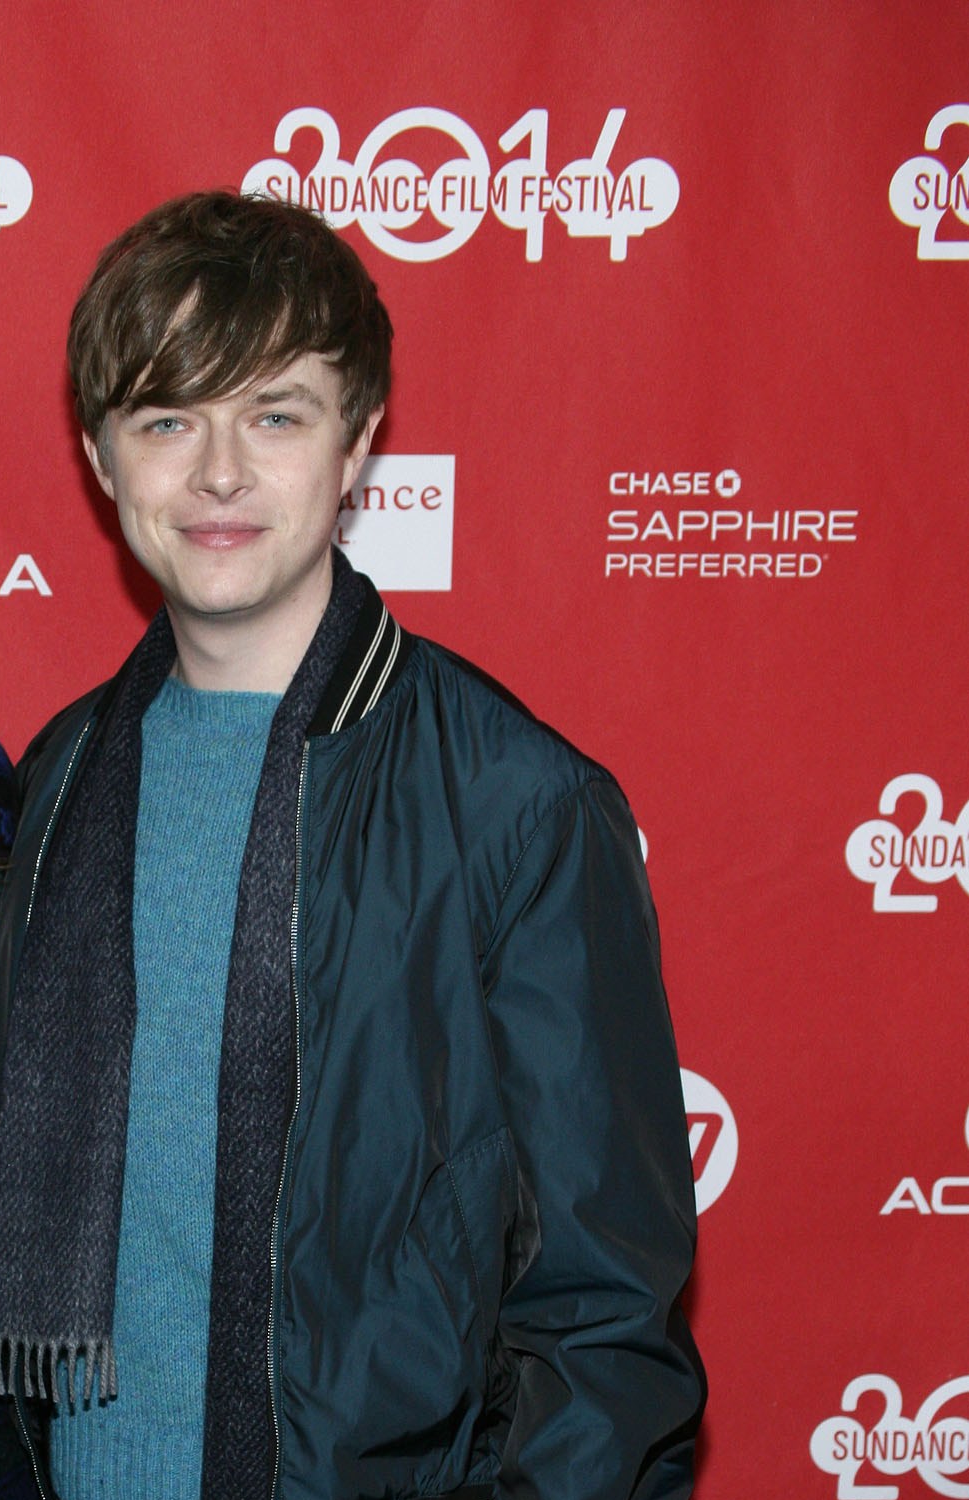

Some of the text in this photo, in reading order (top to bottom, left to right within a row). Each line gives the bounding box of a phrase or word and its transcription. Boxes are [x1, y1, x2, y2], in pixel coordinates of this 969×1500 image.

[266, 176, 653, 213] SUNDANCE FILM FESTIVAL
[274, 107, 644, 262] 2014
[337, 485, 442, 511] ance
[609, 472, 711, 495] CHASE
[607, 510, 858, 541] SAPPHIRE
[604, 553, 822, 578] PREFERRED
[869, 835, 969, 867] SUNDA
[833, 1430, 969, 1462] SUNDANC
